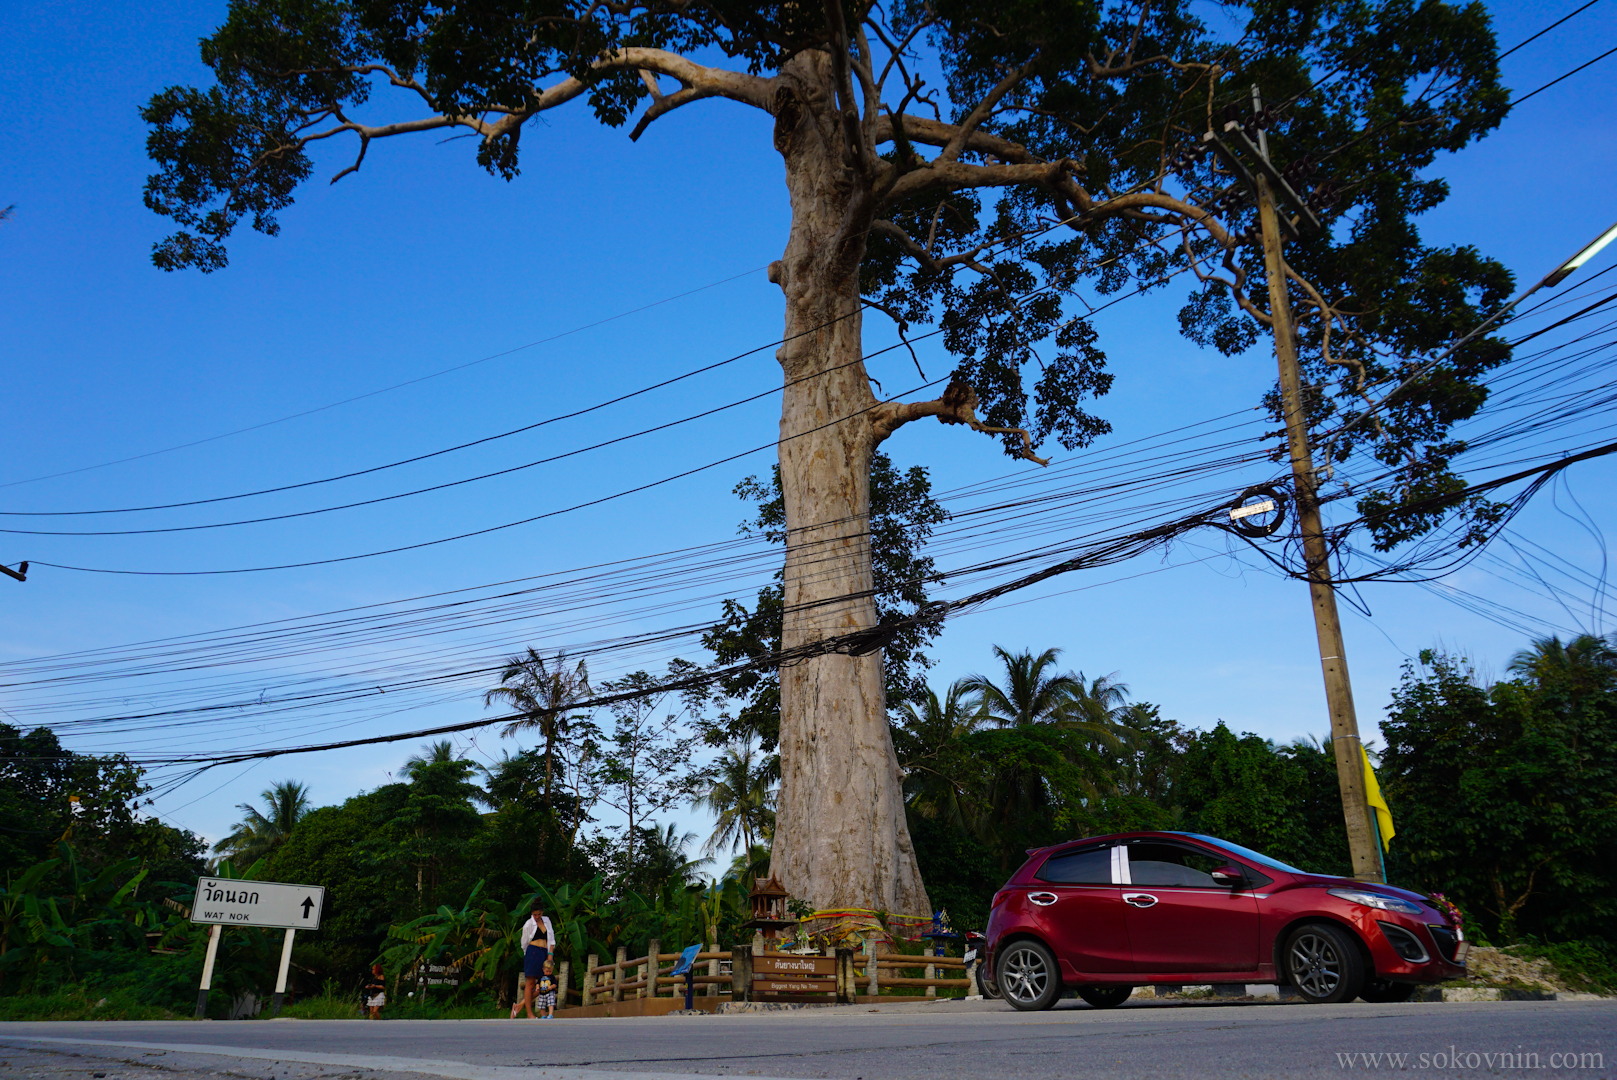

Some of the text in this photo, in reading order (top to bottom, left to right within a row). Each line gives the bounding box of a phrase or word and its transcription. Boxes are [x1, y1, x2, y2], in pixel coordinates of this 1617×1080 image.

[203, 882, 259, 905] วัดนอก
[204, 911, 250, 921] WAT NOK
[775, 959, 815, 972] ต้นยางนาใหญ่
